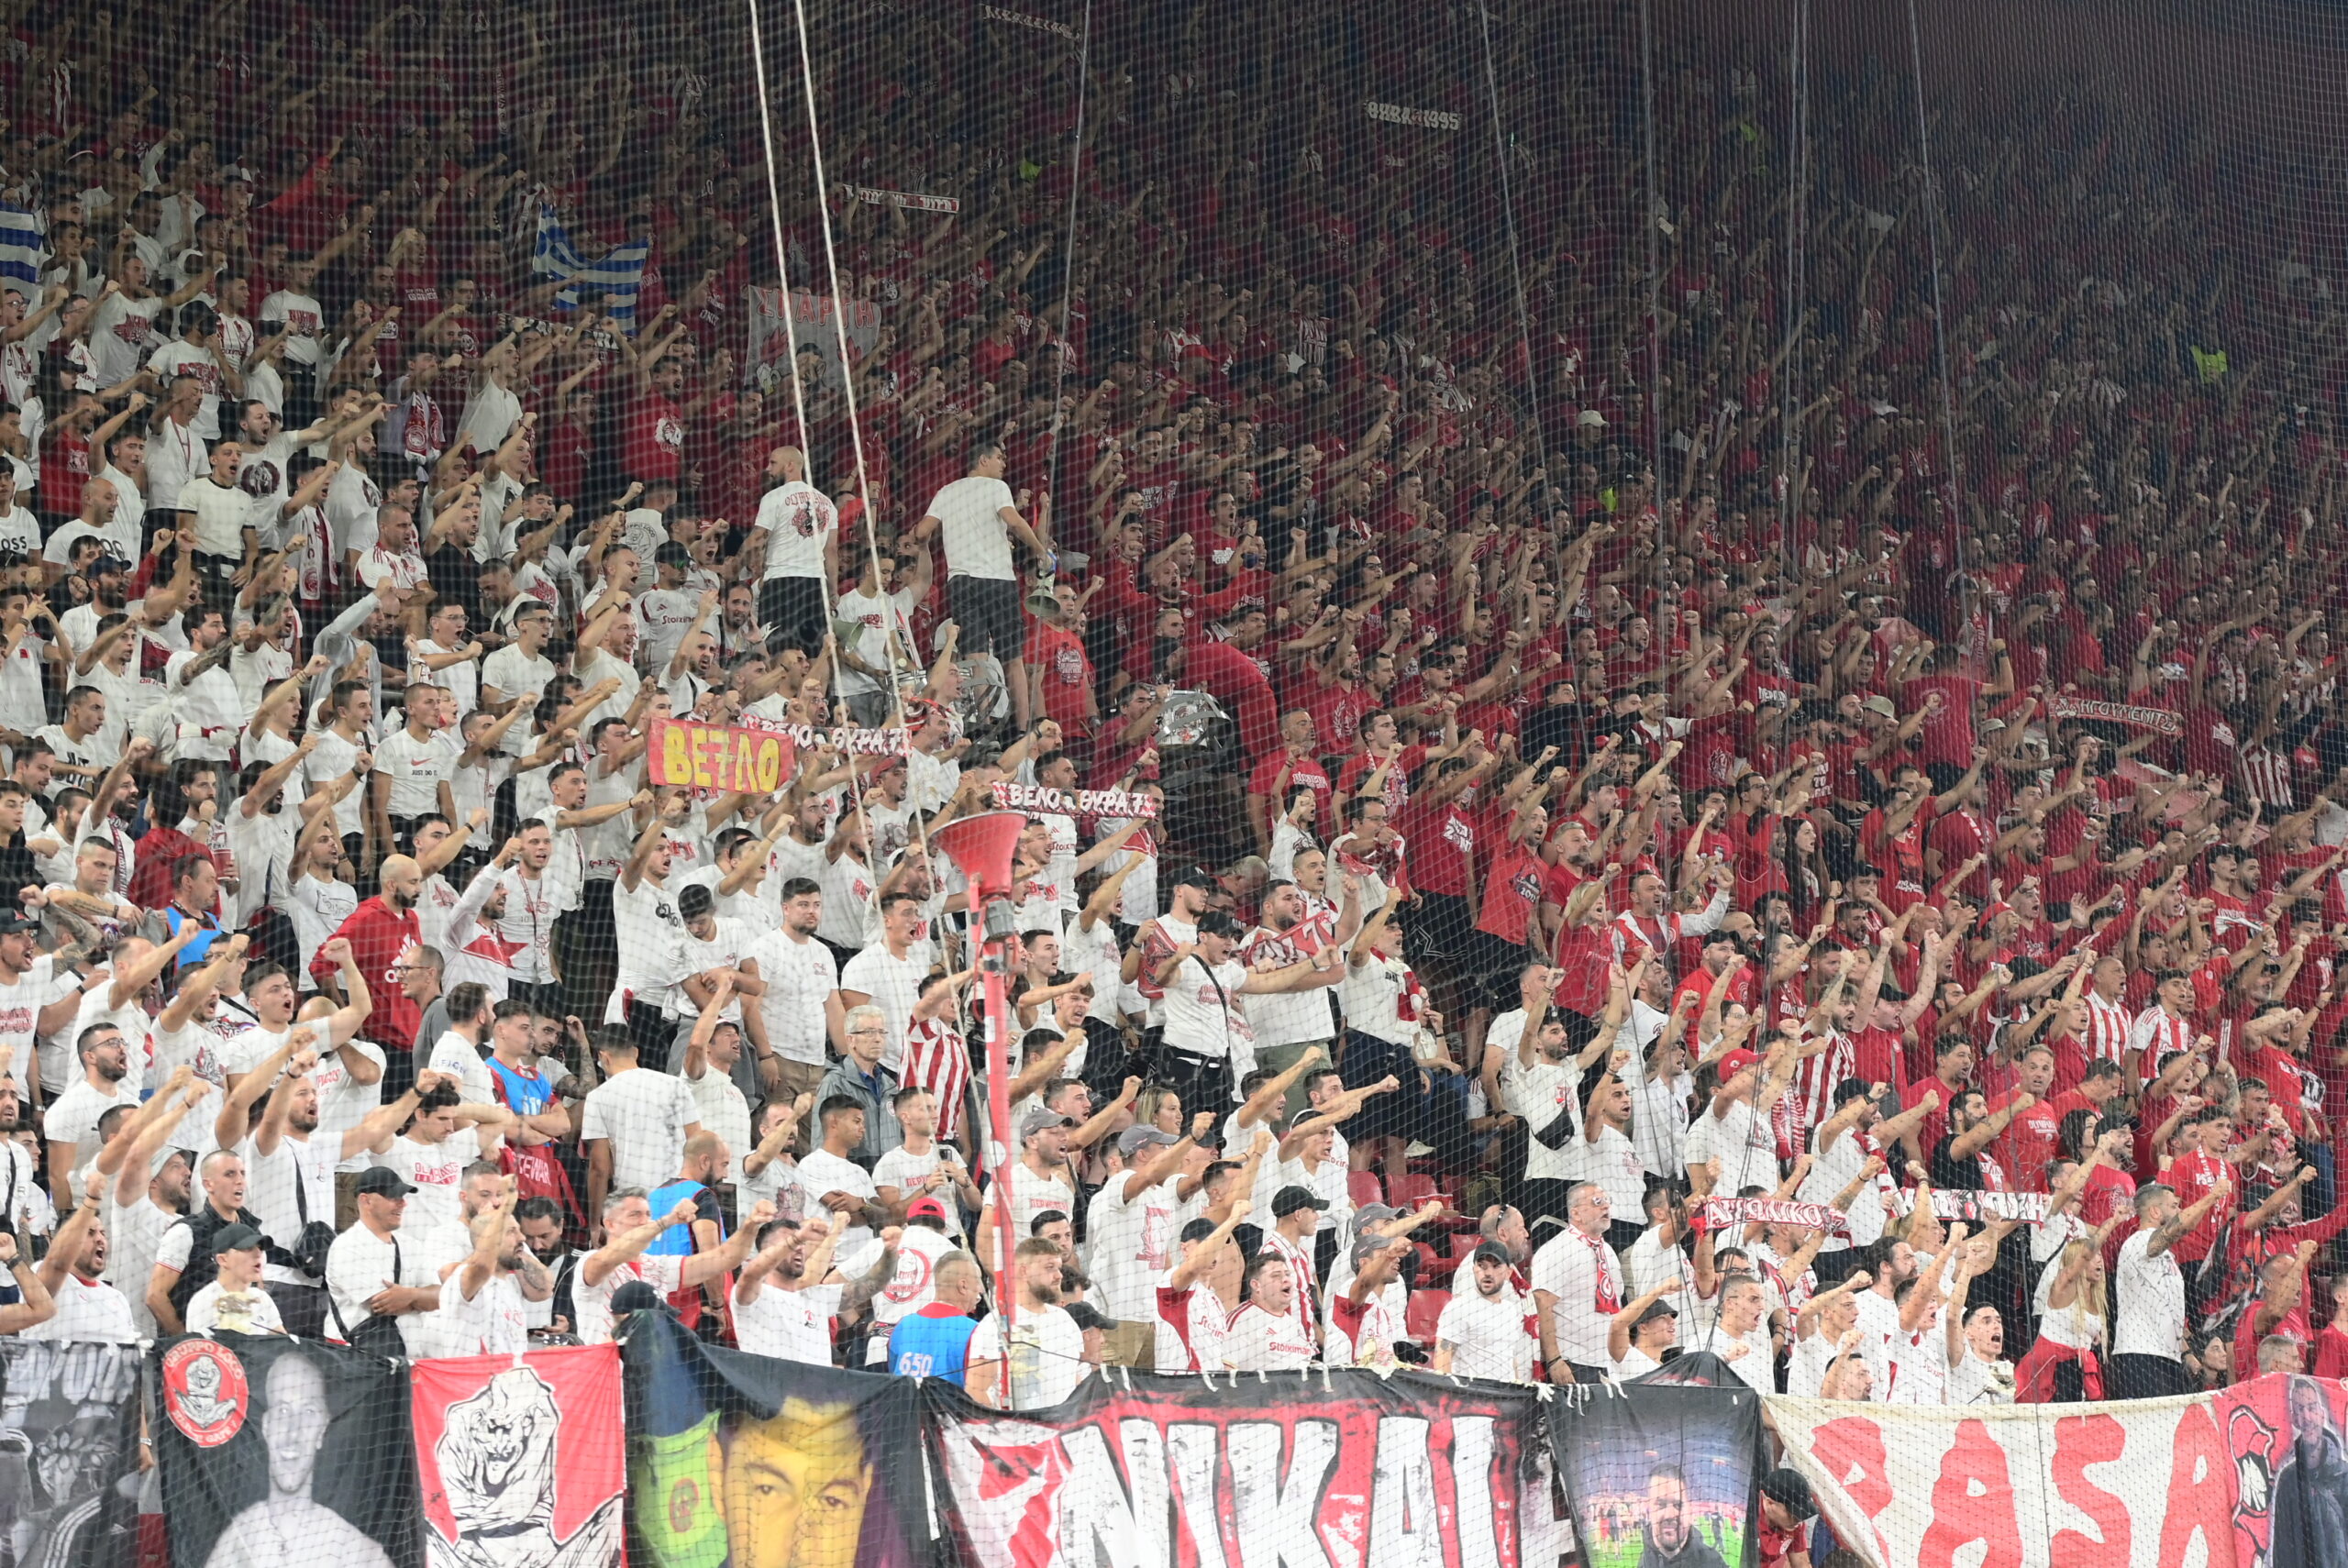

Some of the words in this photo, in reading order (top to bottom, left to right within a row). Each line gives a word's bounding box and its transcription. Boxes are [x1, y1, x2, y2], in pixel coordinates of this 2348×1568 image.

[1423, 109, 1460, 130] 1995
[758, 289, 874, 328] ΣΠΑΡΤΗ
[1009, 783, 1061, 811] ΒΕΛΟ
[1080, 789, 1129, 814] ΘΥΡΑ
[1268, 1341, 1312, 1357] Stoiximan
[898, 1351, 934, 1376] 650
